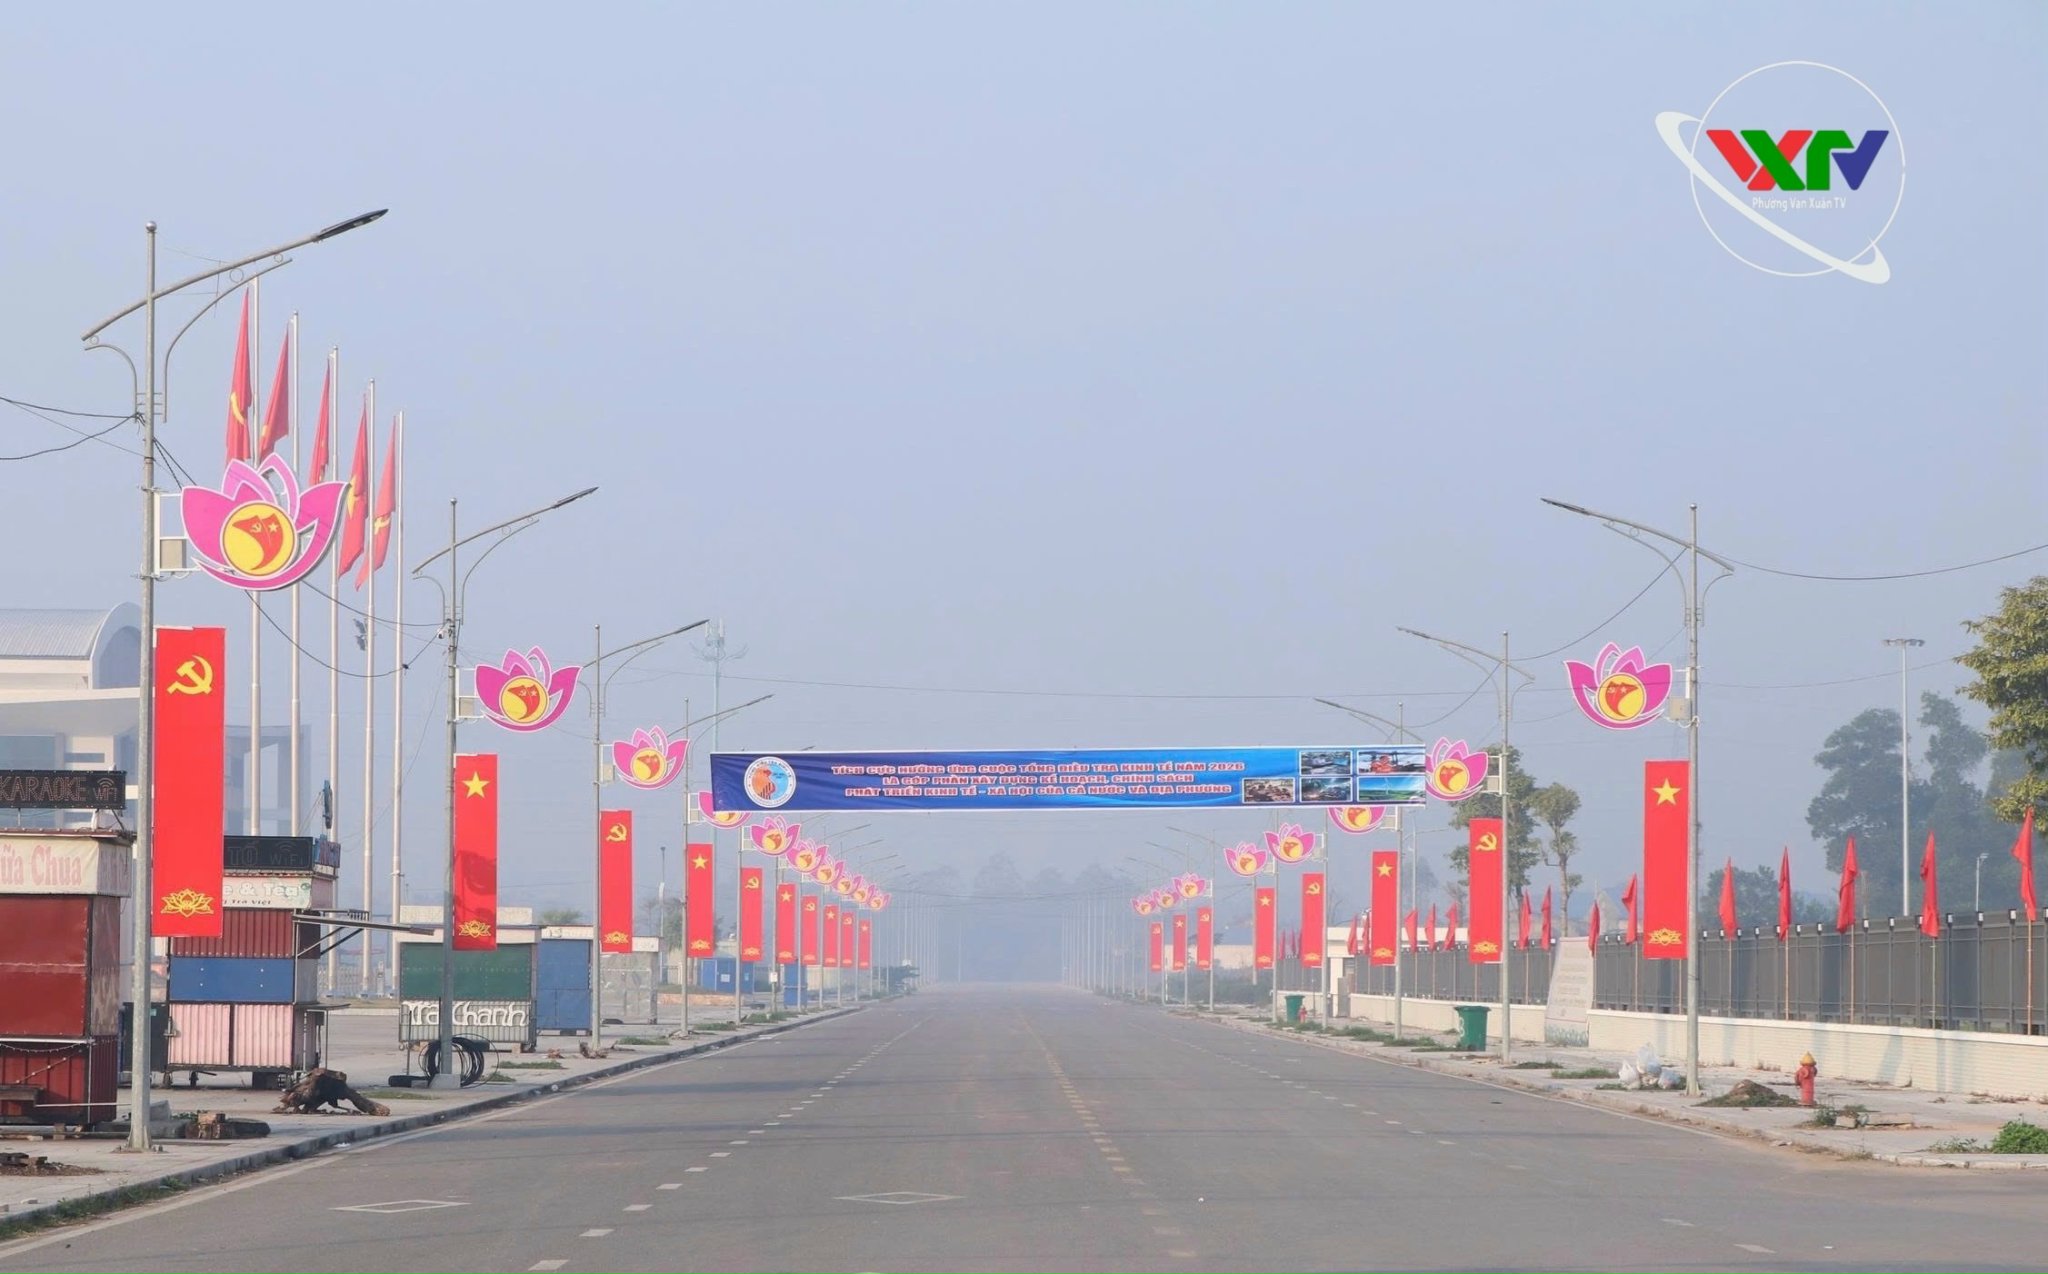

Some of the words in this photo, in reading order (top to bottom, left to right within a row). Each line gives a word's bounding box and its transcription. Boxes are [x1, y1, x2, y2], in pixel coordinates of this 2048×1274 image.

[831, 765, 865, 774] TÍCH
[866, 765, 896, 775] CỰC
[947, 764, 976, 773] ỨNG
[978, 763, 1016, 774] CUỘC
[1019, 762, 1055, 773] TỔNG
[1058, 762, 1089, 772] ĐIỀU
[1092, 763, 1118, 772] TRA
[1120, 763, 1154, 772] KINH
[1156, 761, 1173, 772] TẾ
[1175, 762, 1206, 771] NĂM
[1208, 762, 1245, 771] 2026
[901, 776, 930, 785] GÓP
[932, 774, 968, 784] PHẦN
[970, 775, 997, 784] XÂY
[1000, 775, 1037, 785] DỰNG
[1040, 773, 1057, 784] KẾ
[1111, 773, 1154, 783] CHÍNH
[1156, 773, 1194, 782] SÁCH
[0, 776, 87, 801] KARAOKE
[845, 787, 881, 796] PHÁT
[883, 785, 921, 796] TRIỂN
[924, 787, 958, 796] KINH
[960, 785, 977, 796] TẾ
[1008, 786, 1033, 796] HỘI
[1035, 785, 1065, 795] CỦA
[1088, 785, 1126, 794] NƯỚC
[1129, 785, 1147, 794] VÀ
[1149, 785, 1173, 795] ĐỊA
[1176, 784, 1232, 793] PHƯƠNG
[0, 843, 24, 886] ữa
[31, 844, 82, 886] Chua
[263, 882, 299, 897] Tea
[453, 1001, 527, 1026] Chanh
